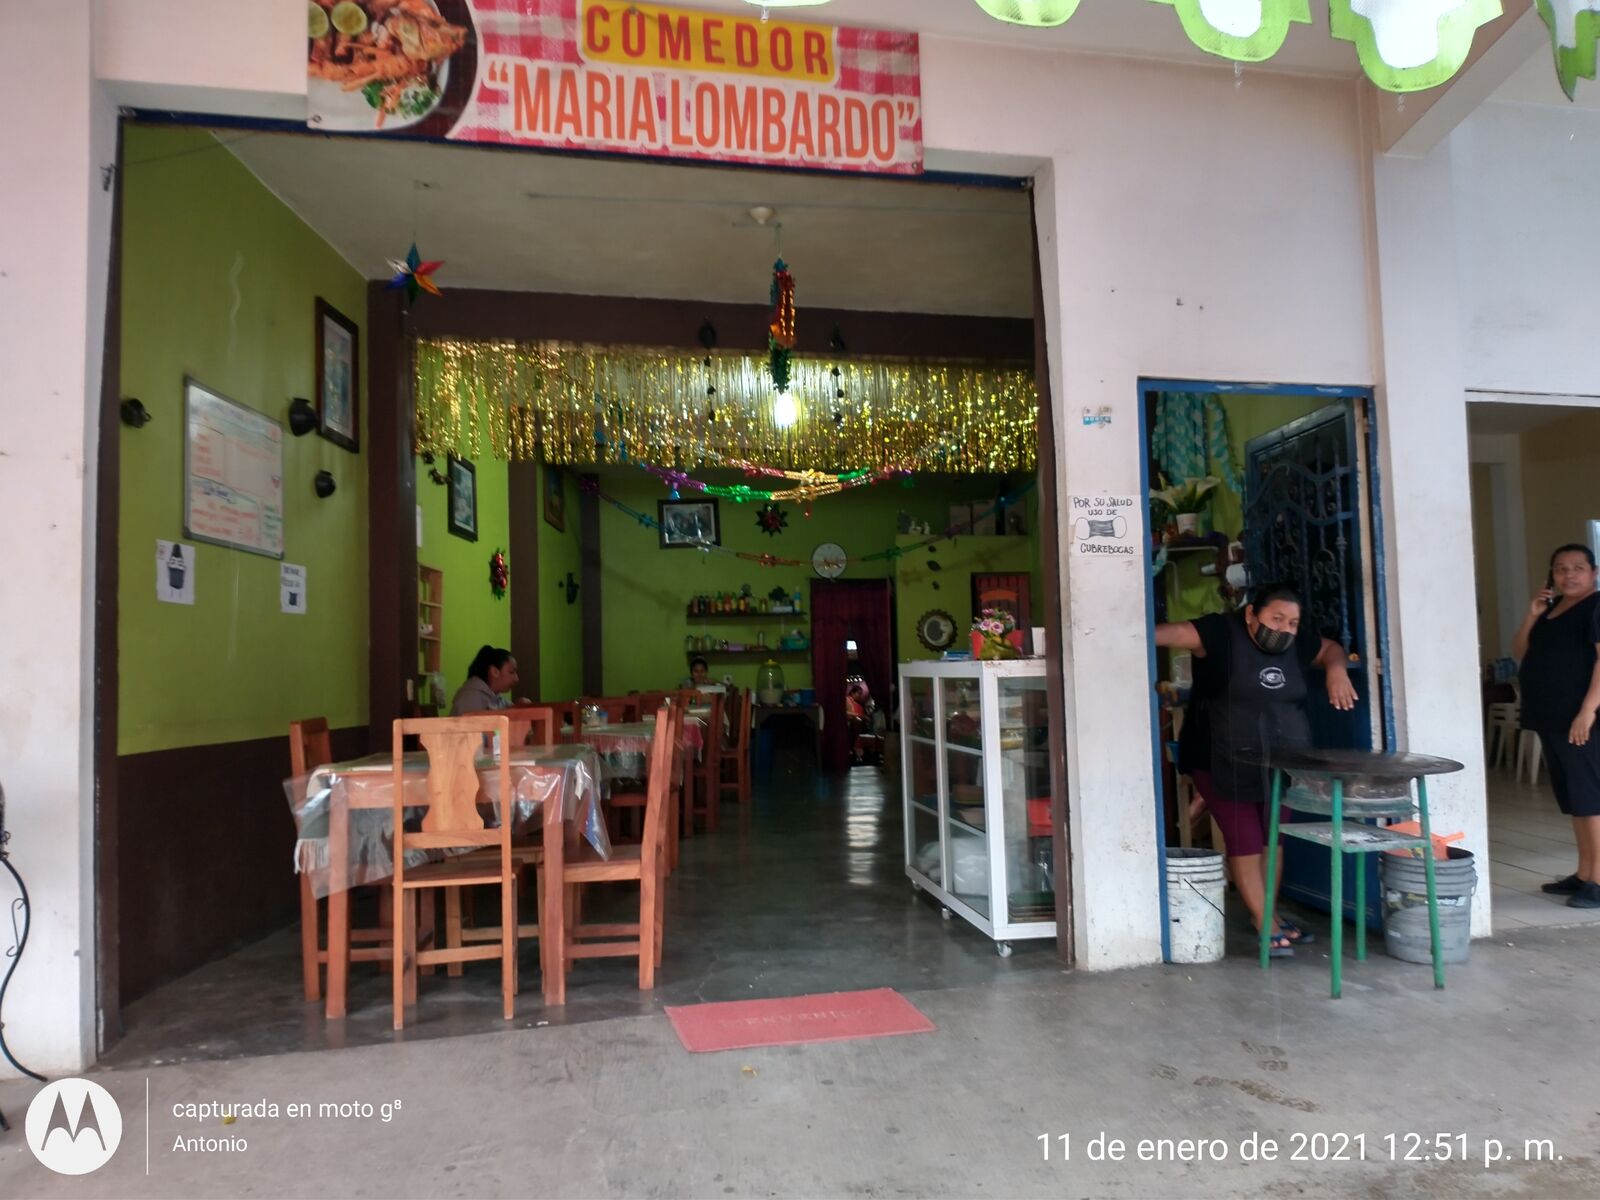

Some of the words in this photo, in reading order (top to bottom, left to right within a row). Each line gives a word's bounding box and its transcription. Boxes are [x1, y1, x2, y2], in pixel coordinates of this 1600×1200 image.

[586, 6, 829, 75] COMEDOR
[1073, 497, 1091, 508] POR
[1094, 497, 1105, 507] SU
[1106, 497, 1133, 507] SALUD
[1080, 543, 1134, 554] CUBREBOCAS
